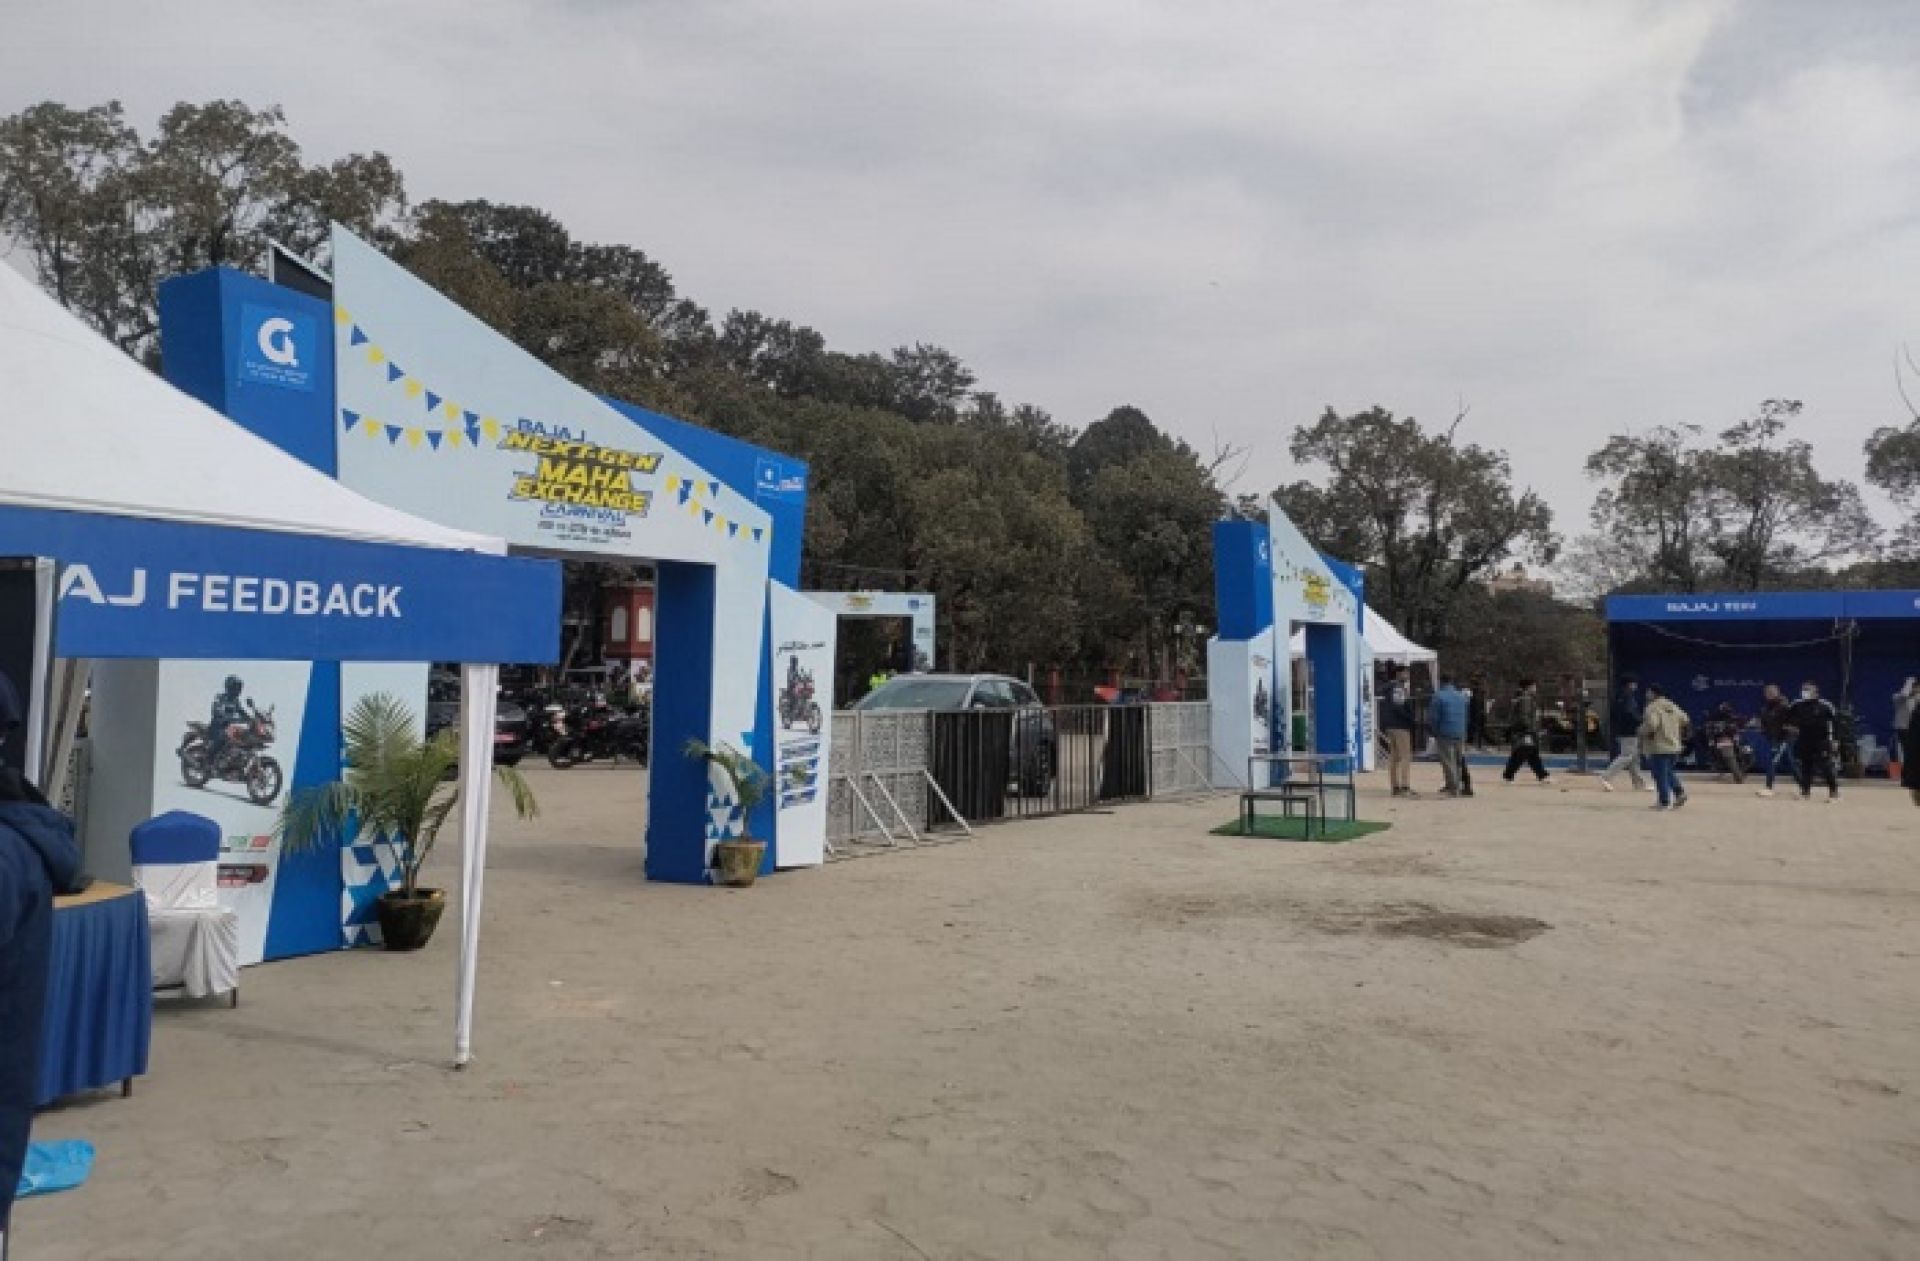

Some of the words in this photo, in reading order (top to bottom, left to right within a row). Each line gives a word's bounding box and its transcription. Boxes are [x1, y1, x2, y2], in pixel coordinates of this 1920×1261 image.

[517, 417, 585, 442] BAJAJ
[537, 455, 630, 492] MAHA
[512, 476, 648, 513] EXCHANGE
[168, 571, 402, 618] FEEDBACK
[1666, 602, 1718, 612] BAJAJ
